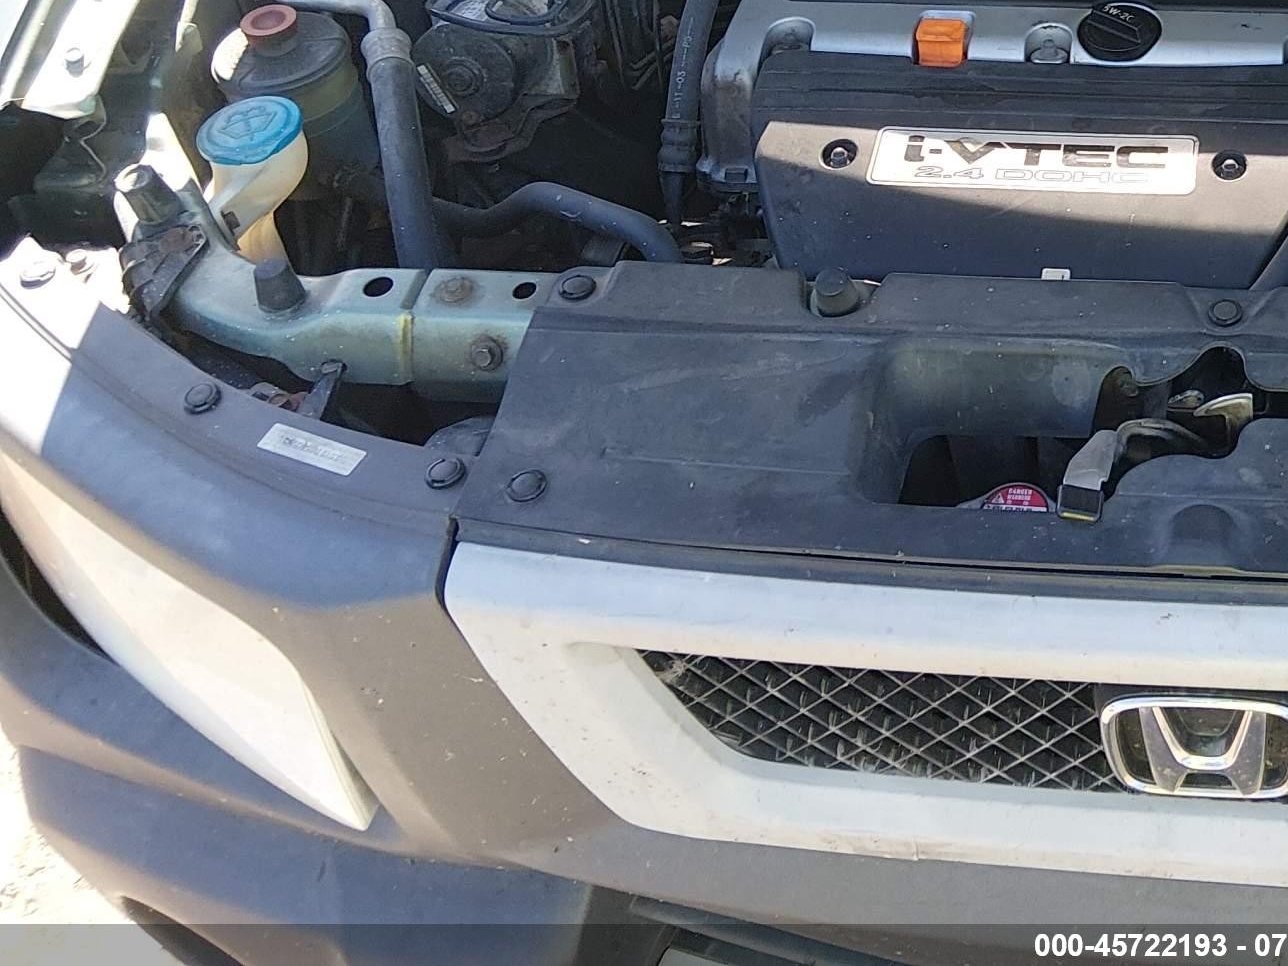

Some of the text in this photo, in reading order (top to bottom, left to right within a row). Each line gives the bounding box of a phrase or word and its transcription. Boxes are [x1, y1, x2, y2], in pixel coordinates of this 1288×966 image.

[904, 134, 1169, 169] i-VTEC
[914, 165, 1149, 183] 2.4 DOHC
